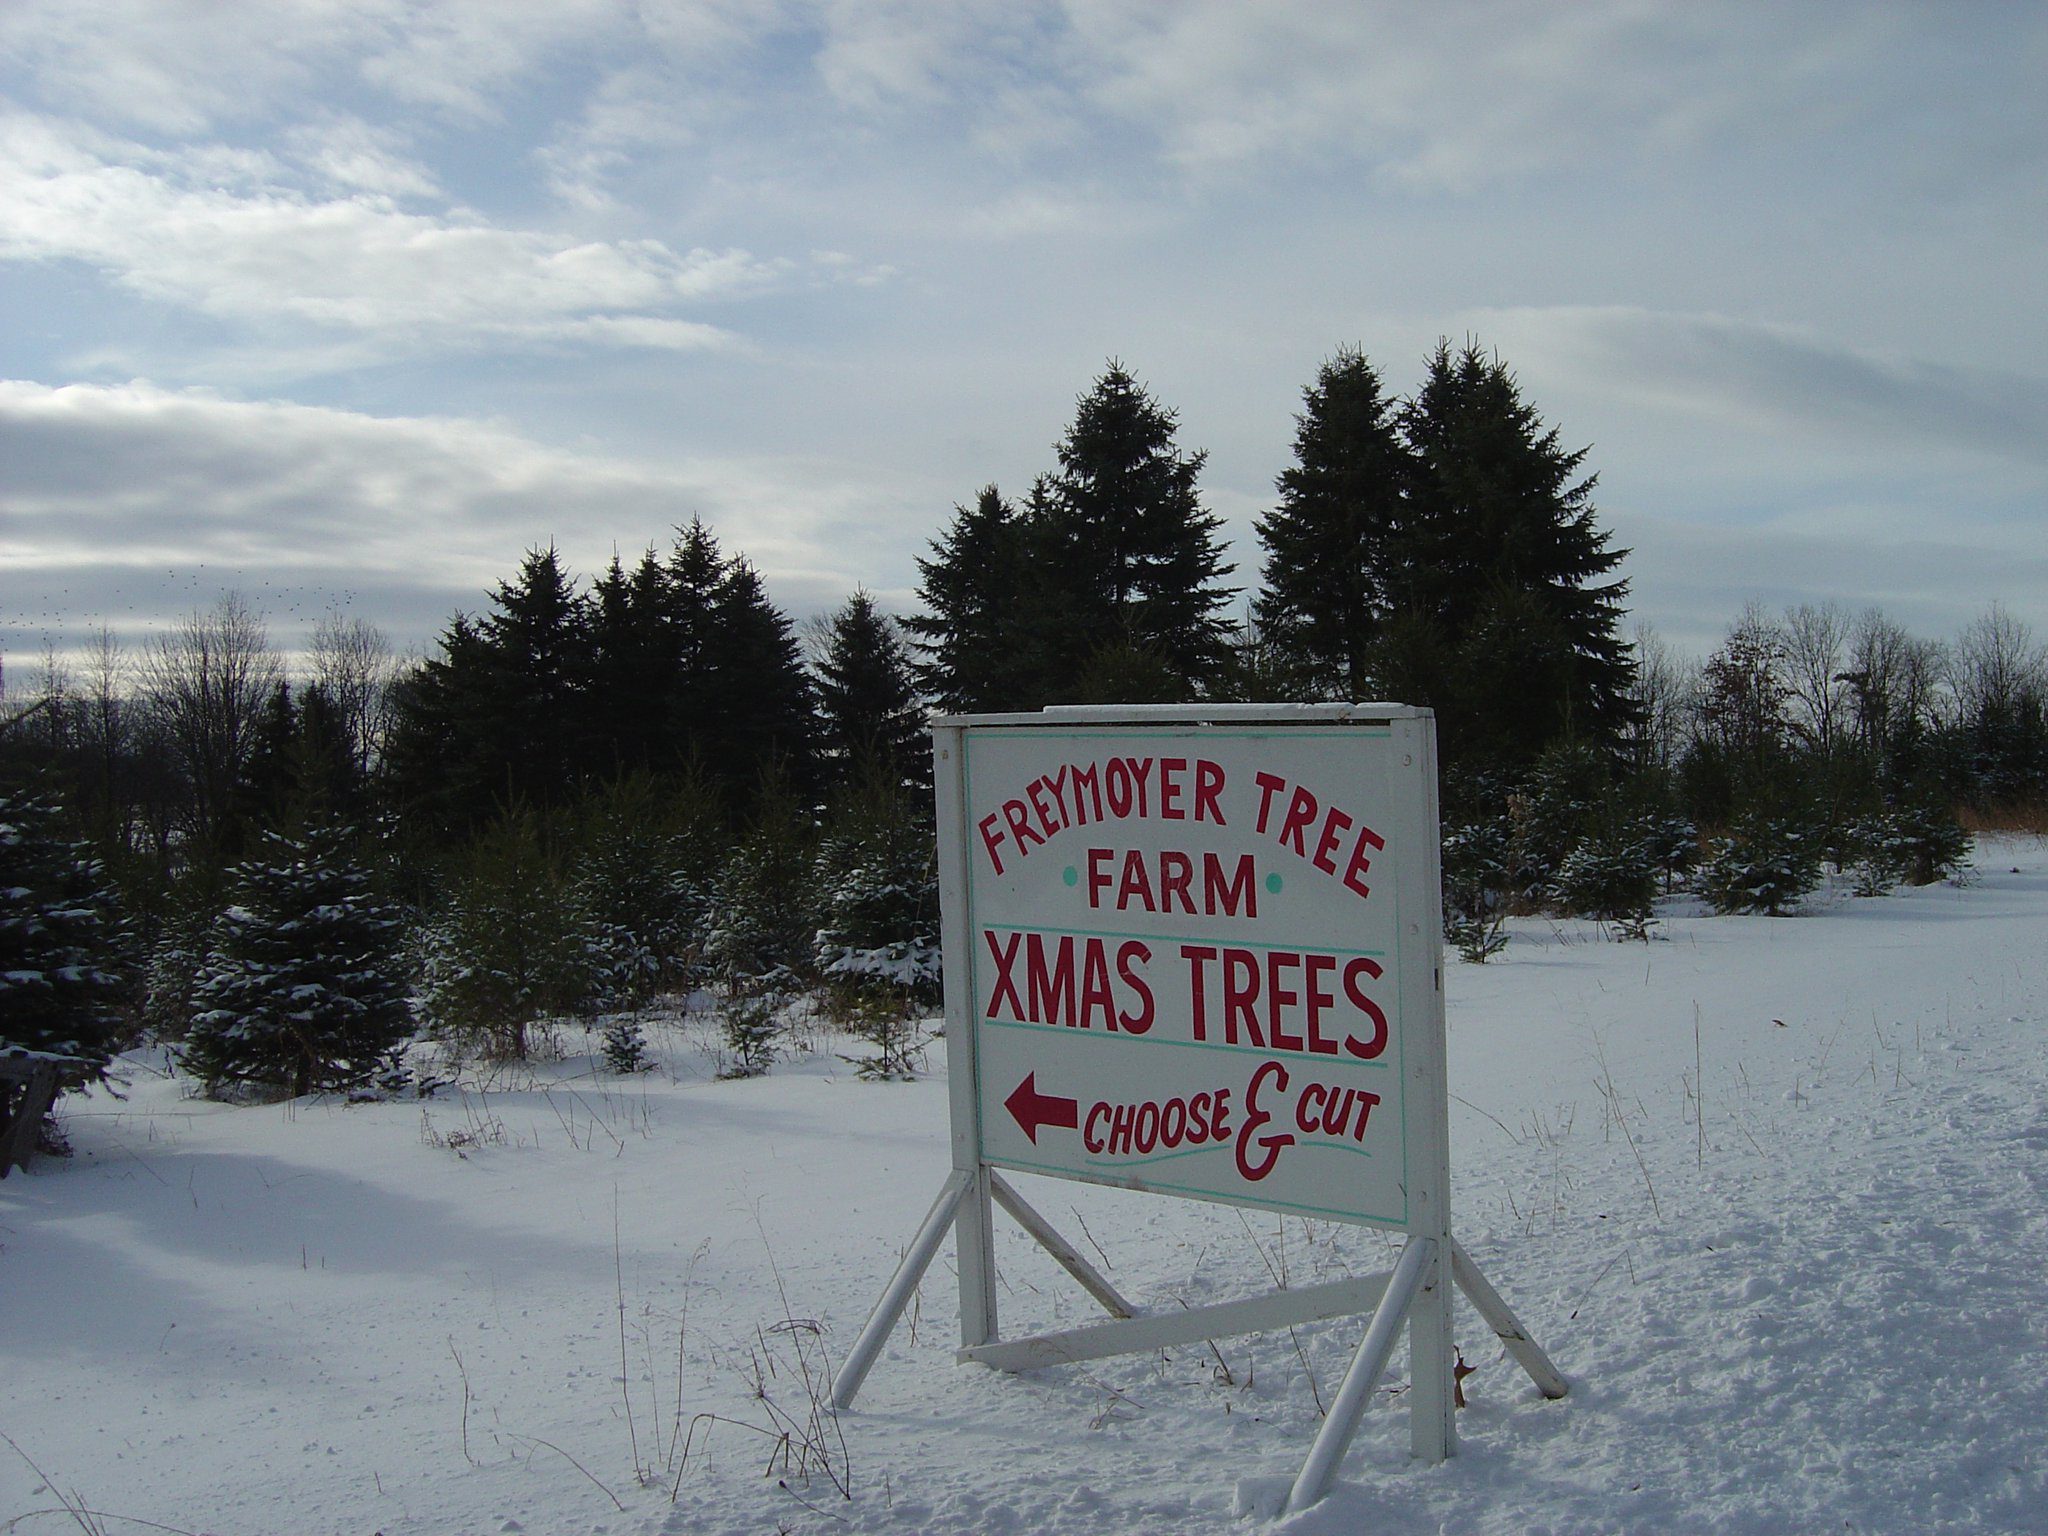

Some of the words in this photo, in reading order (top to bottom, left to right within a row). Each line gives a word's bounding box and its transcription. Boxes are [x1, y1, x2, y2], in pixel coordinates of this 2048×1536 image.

[978, 757, 1226, 876] FREYMOYER
[1254, 771, 1386, 899] TREE
[1087, 848, 1258, 918] FARM
[983, 930, 1155, 1035] XMAS
[1181, 946, 1389, 1060] TREES
[1083, 1088, 1232, 1155] CHOOSE
[1235, 1061, 1295, 1181] &
[1296, 1082, 1381, 1142] CUT
